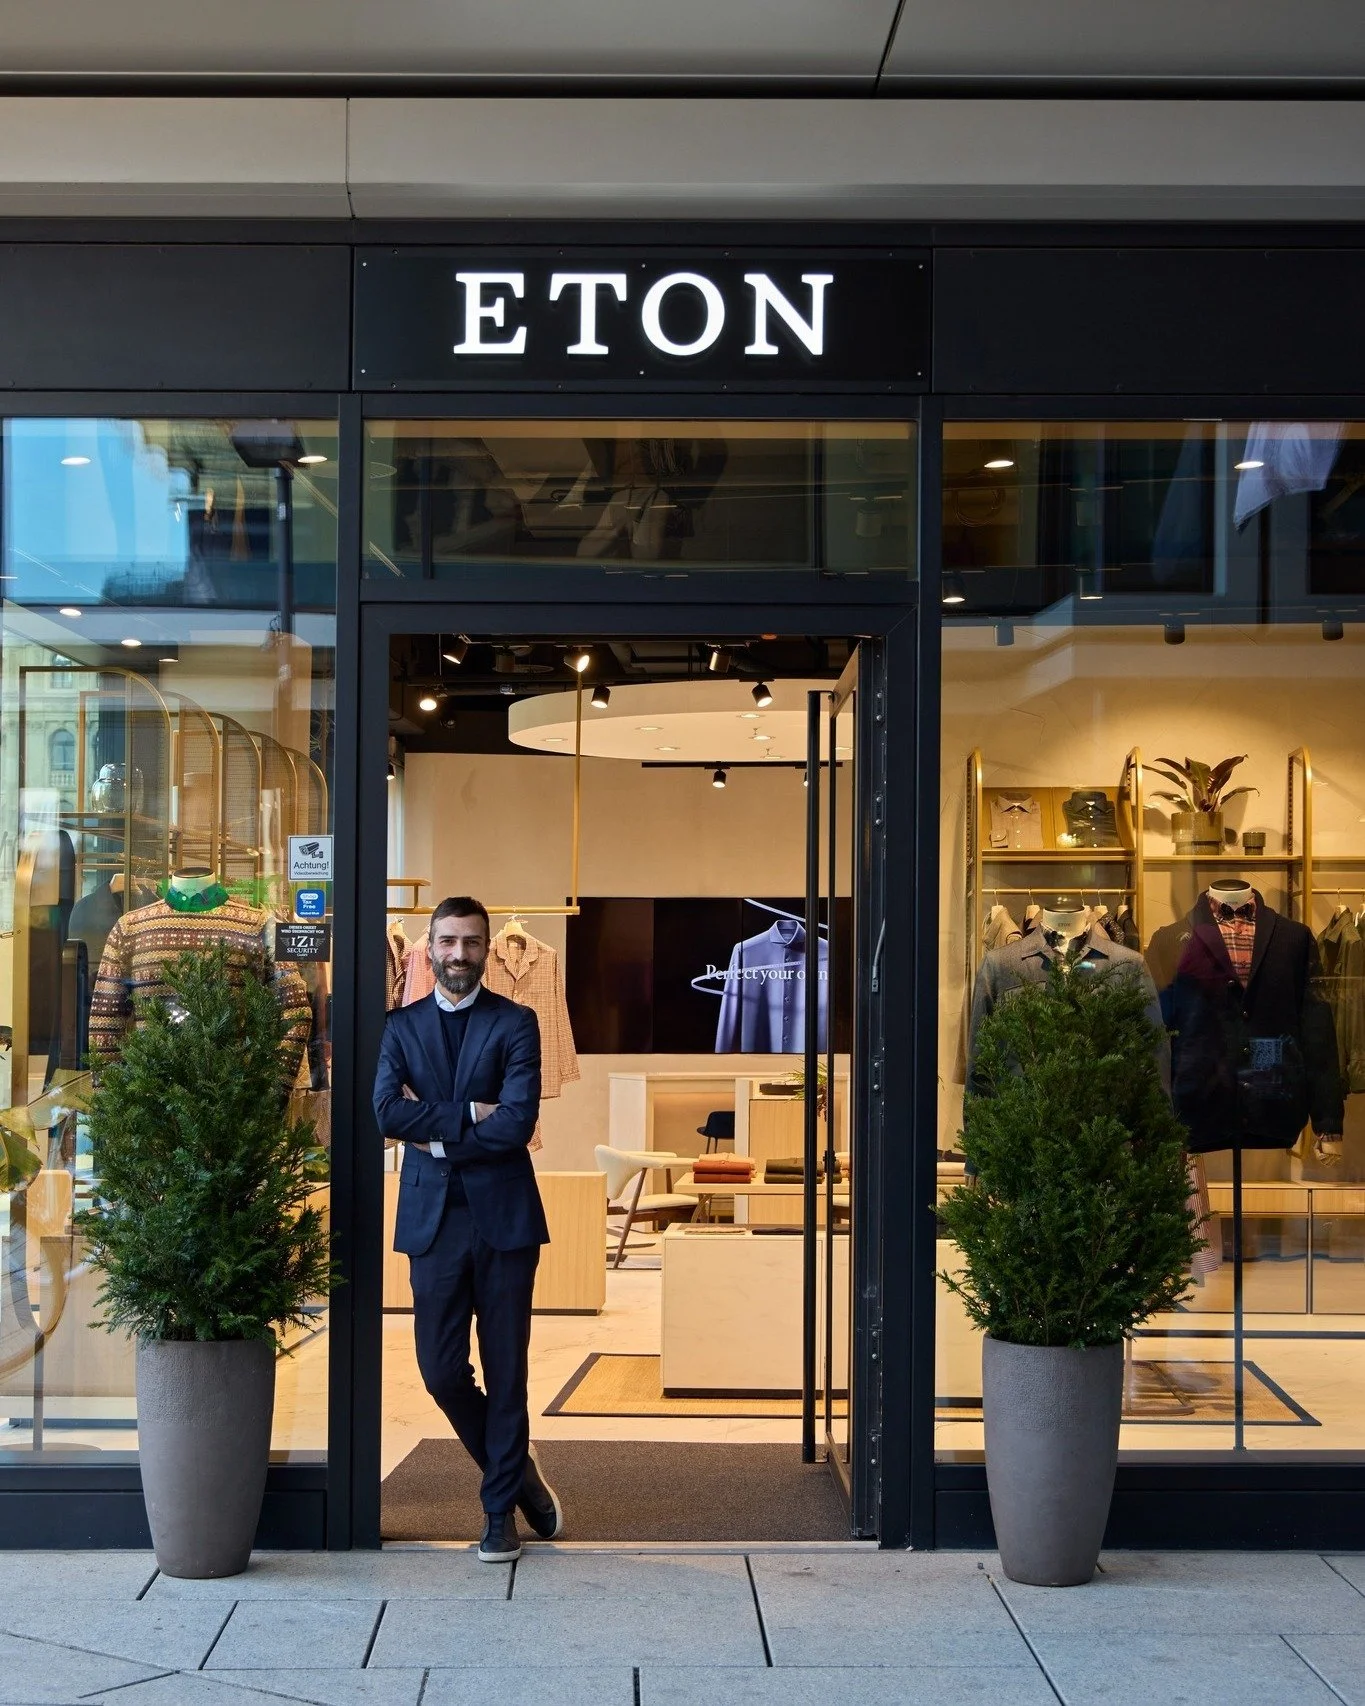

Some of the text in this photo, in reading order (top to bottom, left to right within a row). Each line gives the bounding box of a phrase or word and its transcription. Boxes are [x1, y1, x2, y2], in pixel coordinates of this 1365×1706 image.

[453, 272, 834, 356] ETON
[293, 861, 330, 871] Achtung!
[291, 935, 315, 948] IZI
[706, 964, 828, 986] Perfect your on
